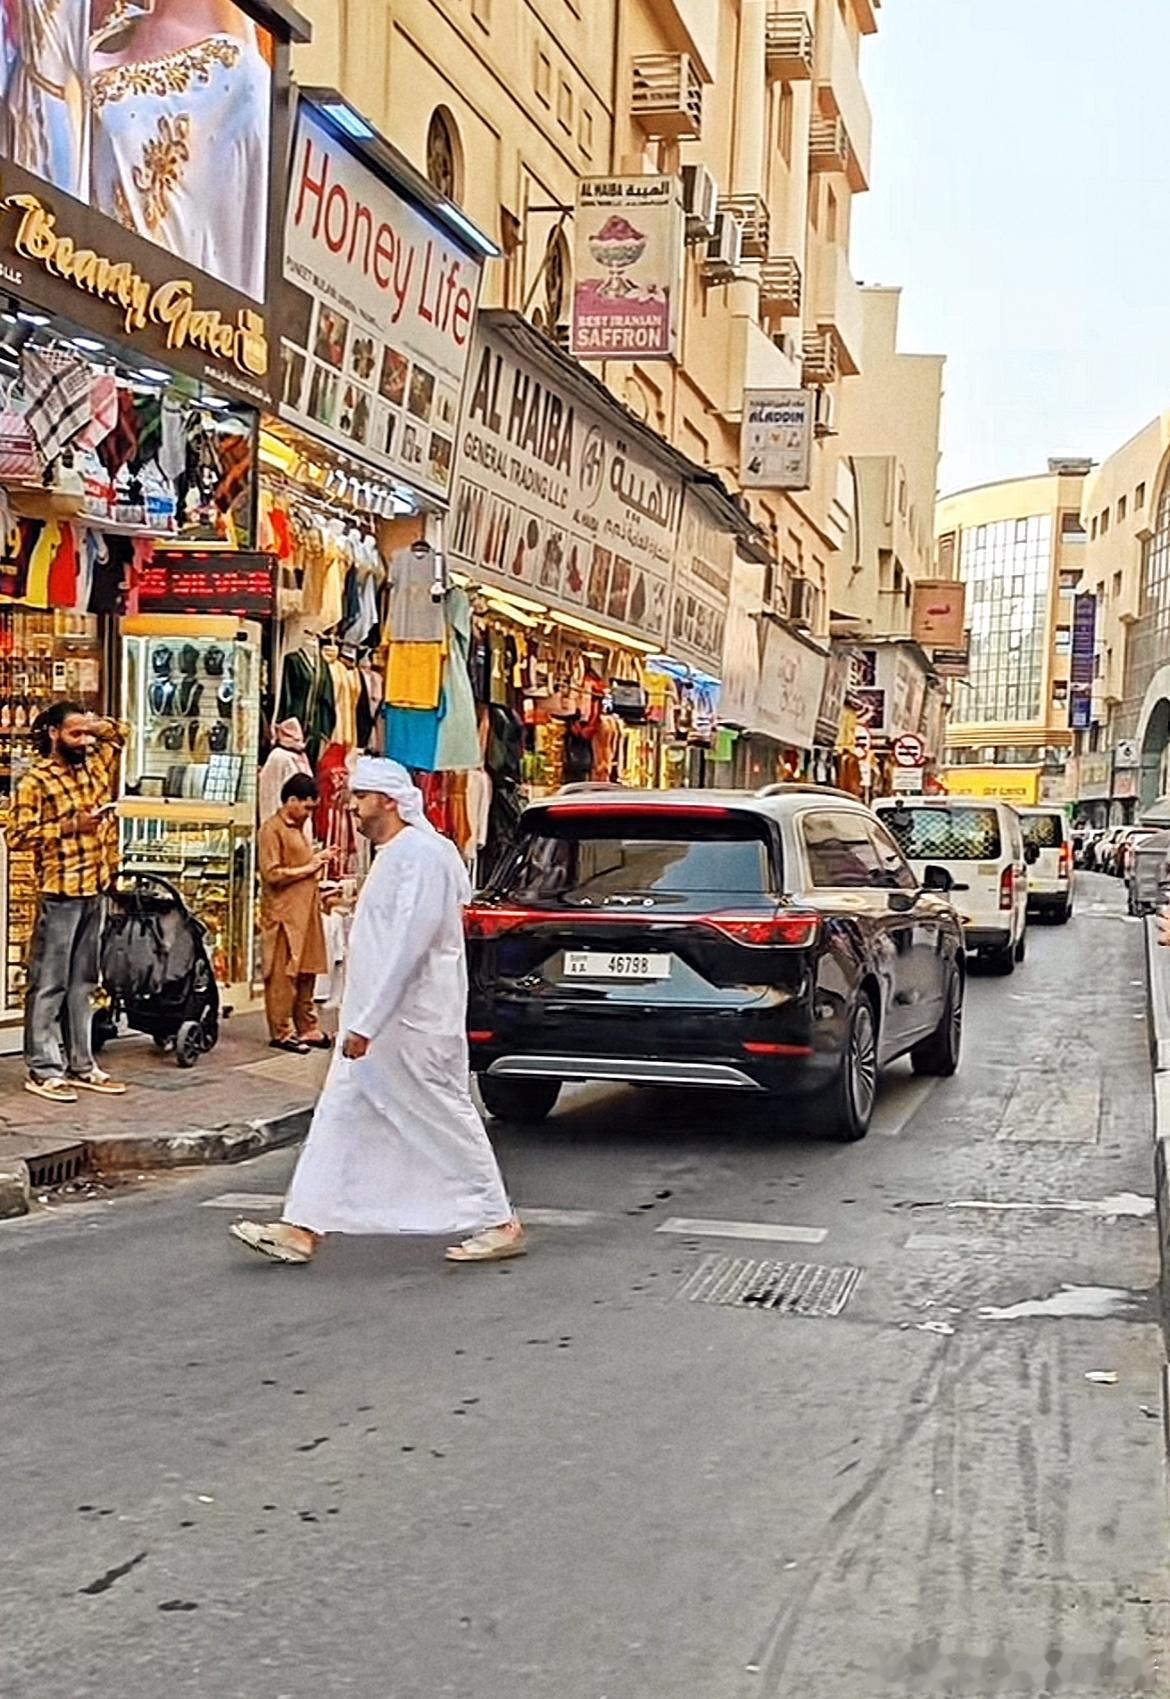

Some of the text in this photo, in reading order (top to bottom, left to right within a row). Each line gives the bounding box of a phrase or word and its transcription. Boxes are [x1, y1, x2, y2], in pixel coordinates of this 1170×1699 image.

[581, 183, 592, 197] AL
[295, 138, 473, 346] Honey Life
[576, 328, 662, 348] SAFFRON
[469, 345, 504, 435] AL
[506, 368, 575, 477] HAIBA
[748, 410, 805, 424] ALADDIN
[463, 431, 508, 479] GENERAL
[509, 457, 549, 500] TRADING
[610, 439, 679, 534] الهيبة
